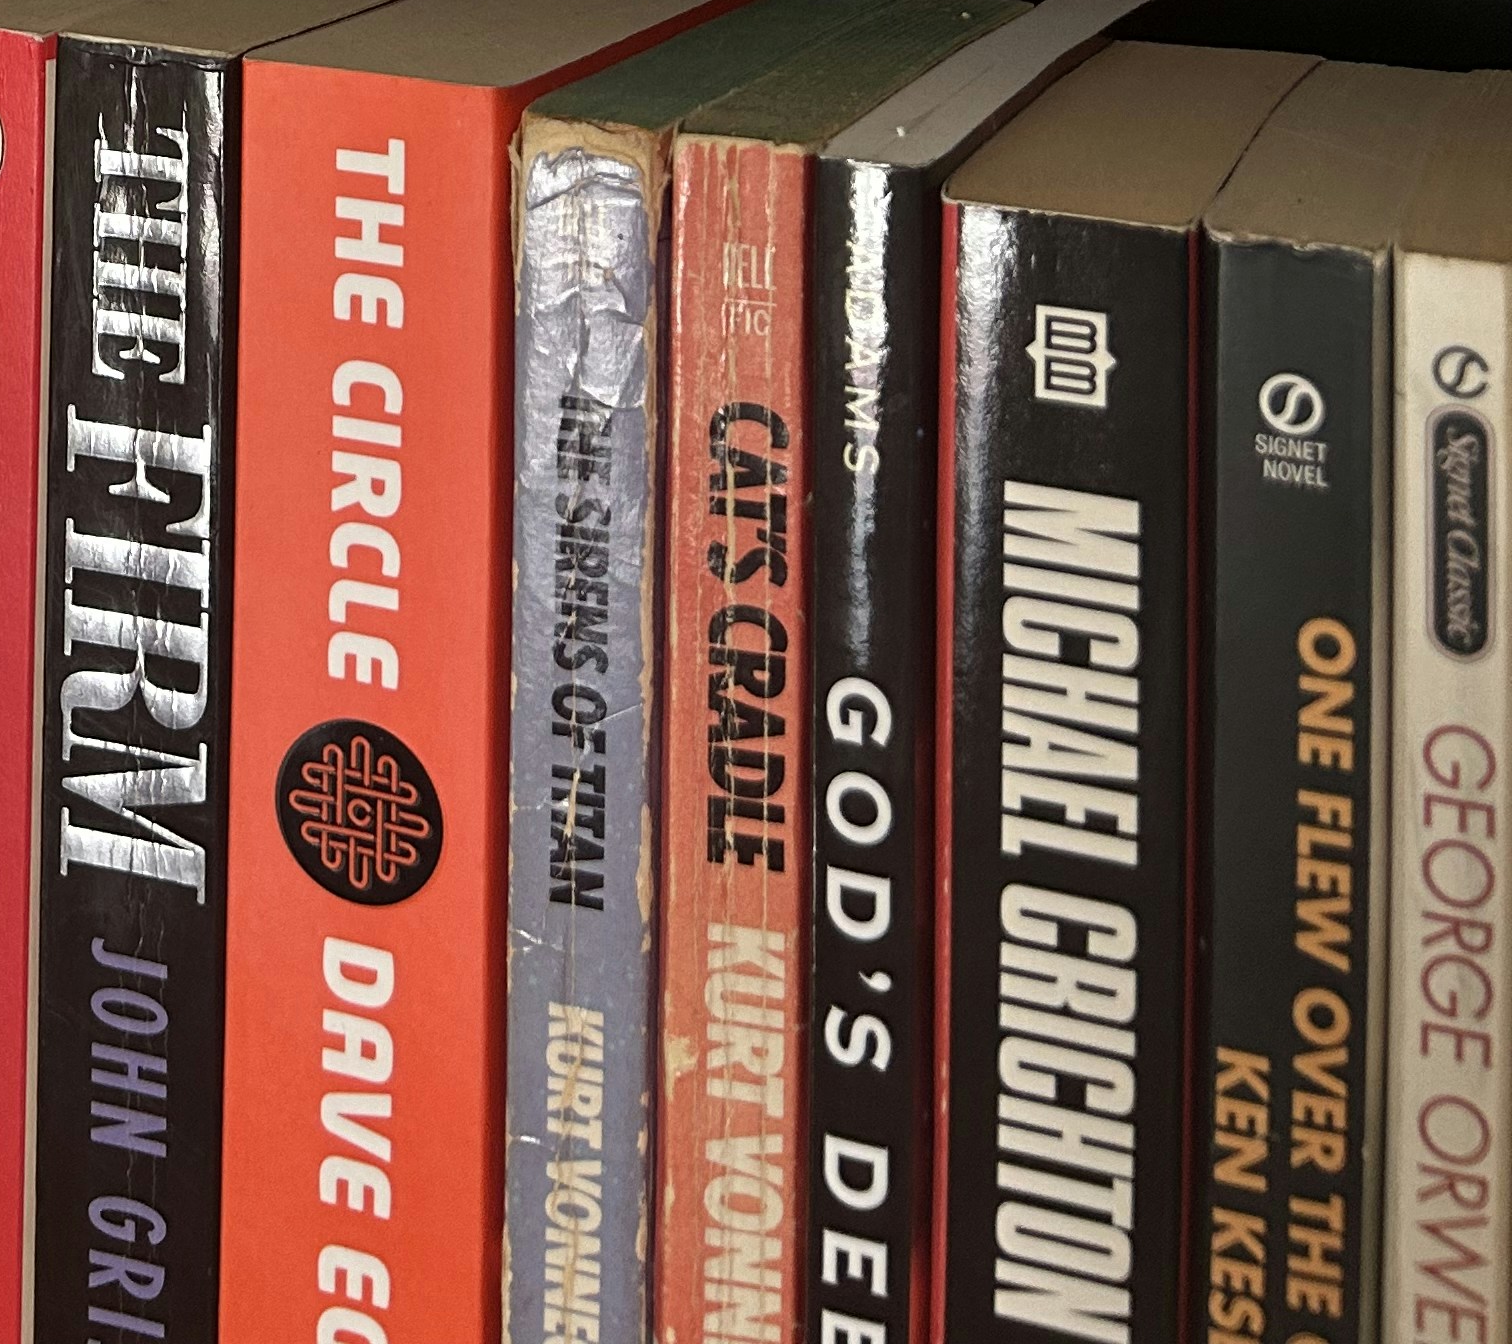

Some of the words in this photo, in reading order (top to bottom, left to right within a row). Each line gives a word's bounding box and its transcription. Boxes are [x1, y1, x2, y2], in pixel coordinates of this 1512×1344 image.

[91, 112, 188, 386] THE
[333, 137, 406, 330] THE
[326, 358, 405, 692] CIRCLE
[1254, 432, 1328, 463] SIGNET
[1262, 459, 1330, 490] NOVEL
[59, 402, 213, 906] FIRM
[552, 495, 613, 676] SIRENS
[1000, 479, 1141, 868] MICHAEL
[552, 682, 608, 756] OF
[1297, 616, 1357, 773] ONE
[549, 764, 607, 912] TITAN
[1294, 787, 1355, 974] FLEW
[318, 935, 397, 1221] DAVE
[993, 883, 1139, 1344] CRICHTON
[1288, 987, 1352, 1174] OVER
[1285, 1194, 1346, 1320] THE
